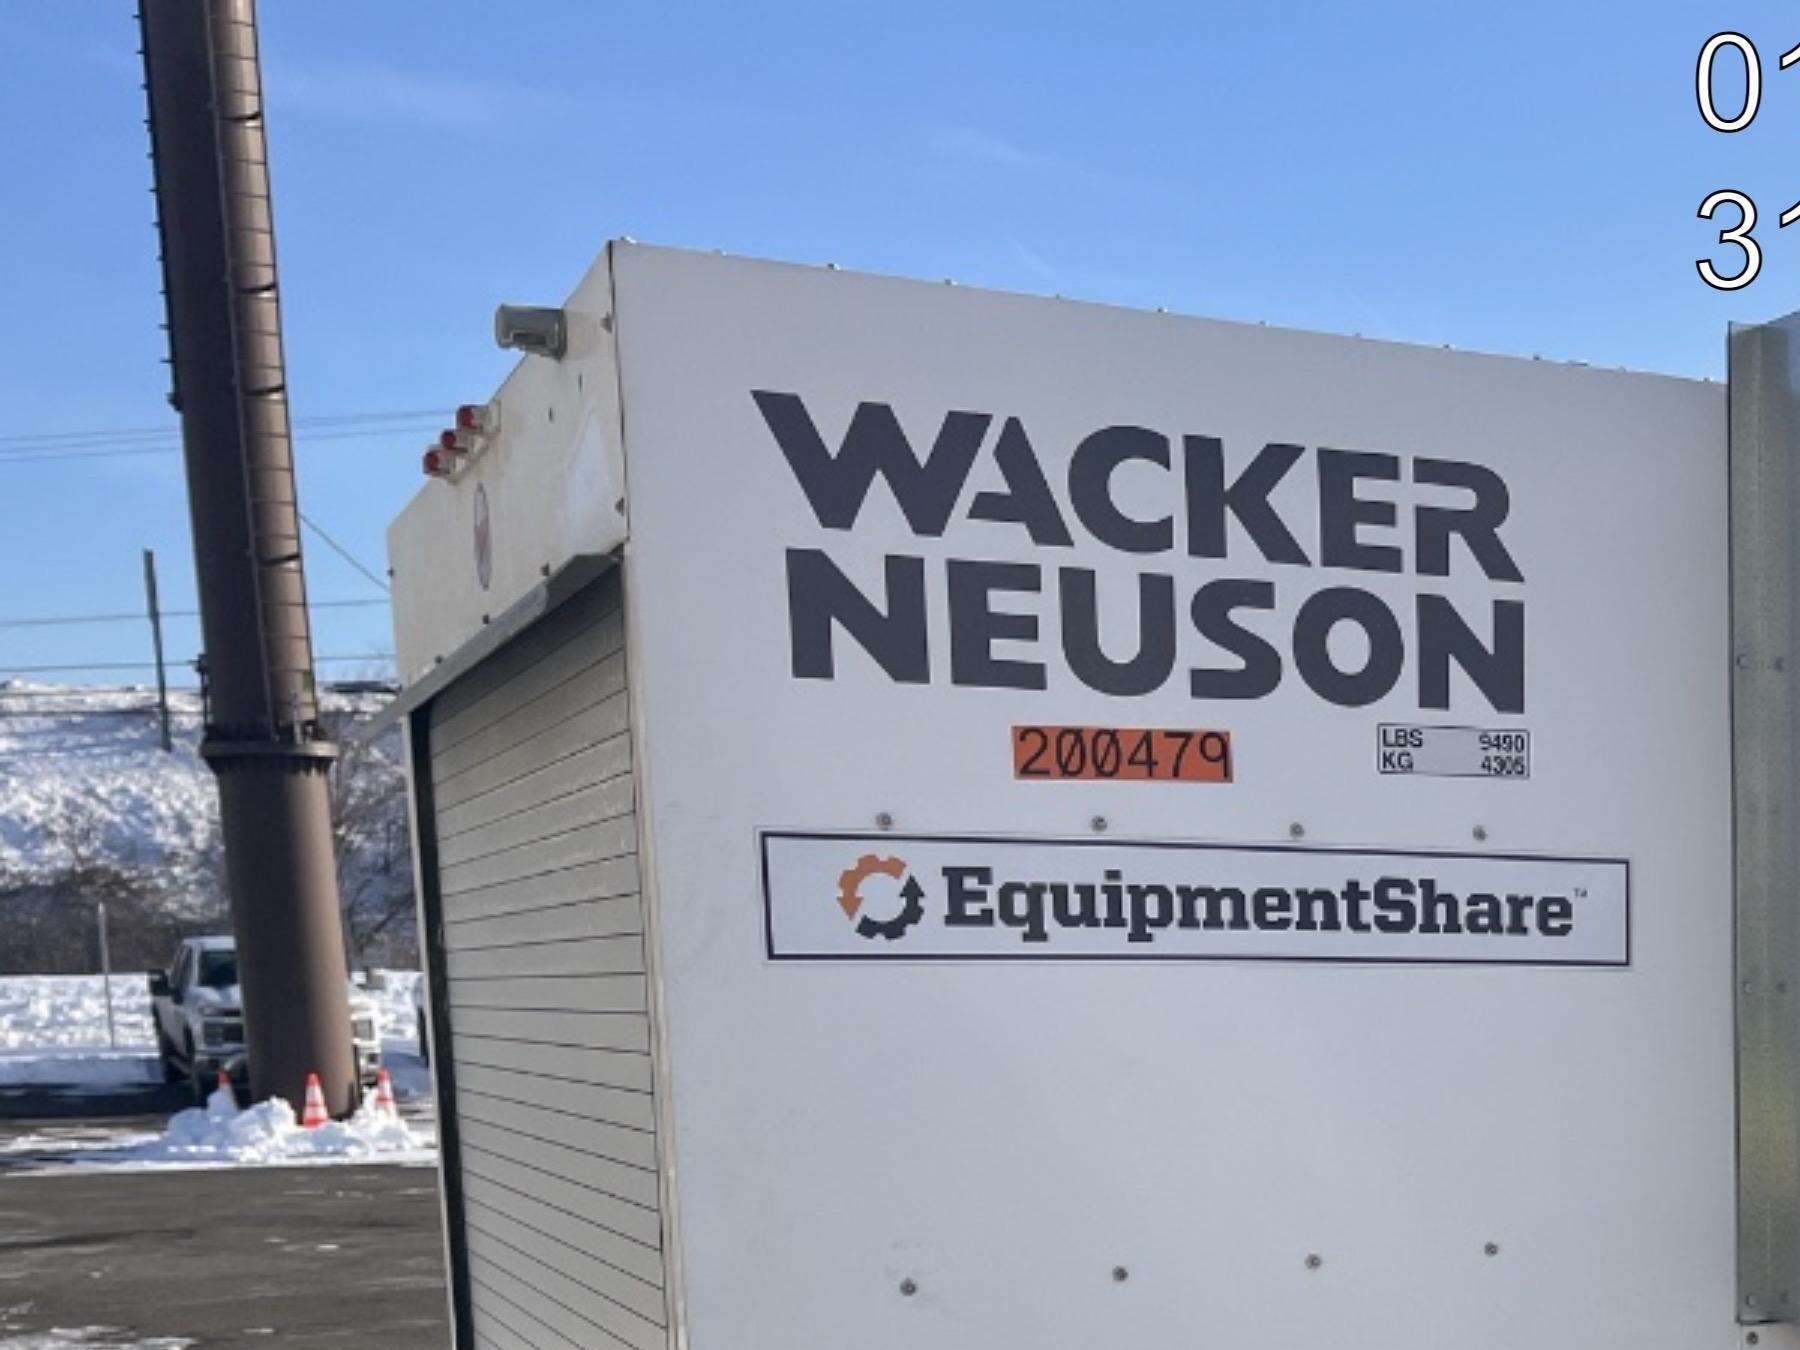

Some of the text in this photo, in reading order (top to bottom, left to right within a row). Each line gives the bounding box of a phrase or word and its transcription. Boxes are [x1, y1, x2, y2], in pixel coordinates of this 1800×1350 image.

[750, 389, 1525, 583] WACKER
[785, 547, 1525, 714] NEUSON
[1018, 727, 1229, 779] 200479
[1382, 728, 1525, 754] LBS 9490
[1382, 750, 1414, 771] KG
[941, 863, 1574, 942] EquipmentShare
